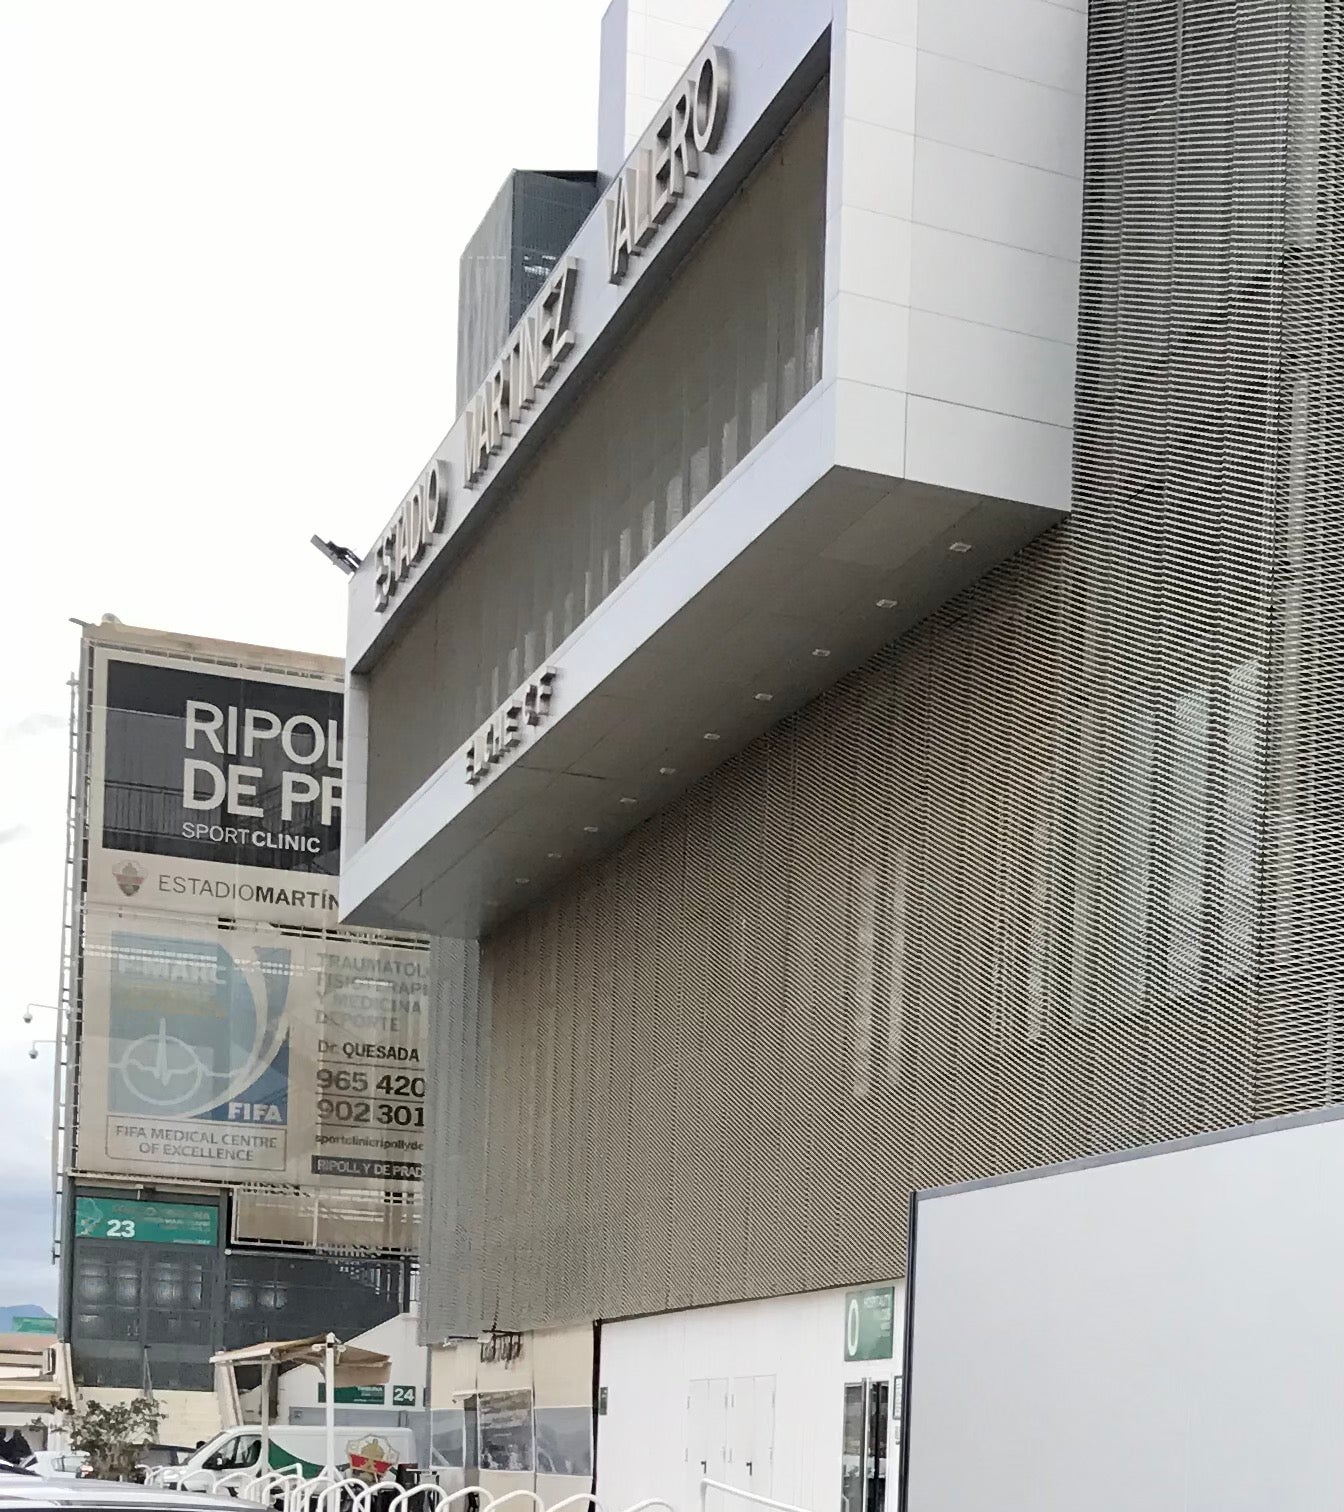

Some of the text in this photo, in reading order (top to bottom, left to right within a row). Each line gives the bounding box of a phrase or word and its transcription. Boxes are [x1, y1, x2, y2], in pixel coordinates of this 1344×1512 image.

[375, 458, 451, 613] ESTADIO
[605, 45, 731, 285] VALERO
[182, 757, 264, 818] DE
[181, 821, 321, 854] SPORTCLINIC
[342, 1041, 420, 1062] QUESADA
[316, 1068, 369, 1092] 965
[228, 1101, 283, 1123] FIFA
[317, 1098, 425, 1127] 902 301
[116, 1125, 278, 1149] FIFA MEDICAL CENTRE
[138, 1142, 254, 1162] OF EXCELLENCE
[317, 1159, 361, 1174] RIPOLL
[362, 1163, 371, 1174] Y
[374, 1164, 391, 1176] DE
[106, 1219, 136, 1238] 23
[393, 1387, 415, 1402] 24
